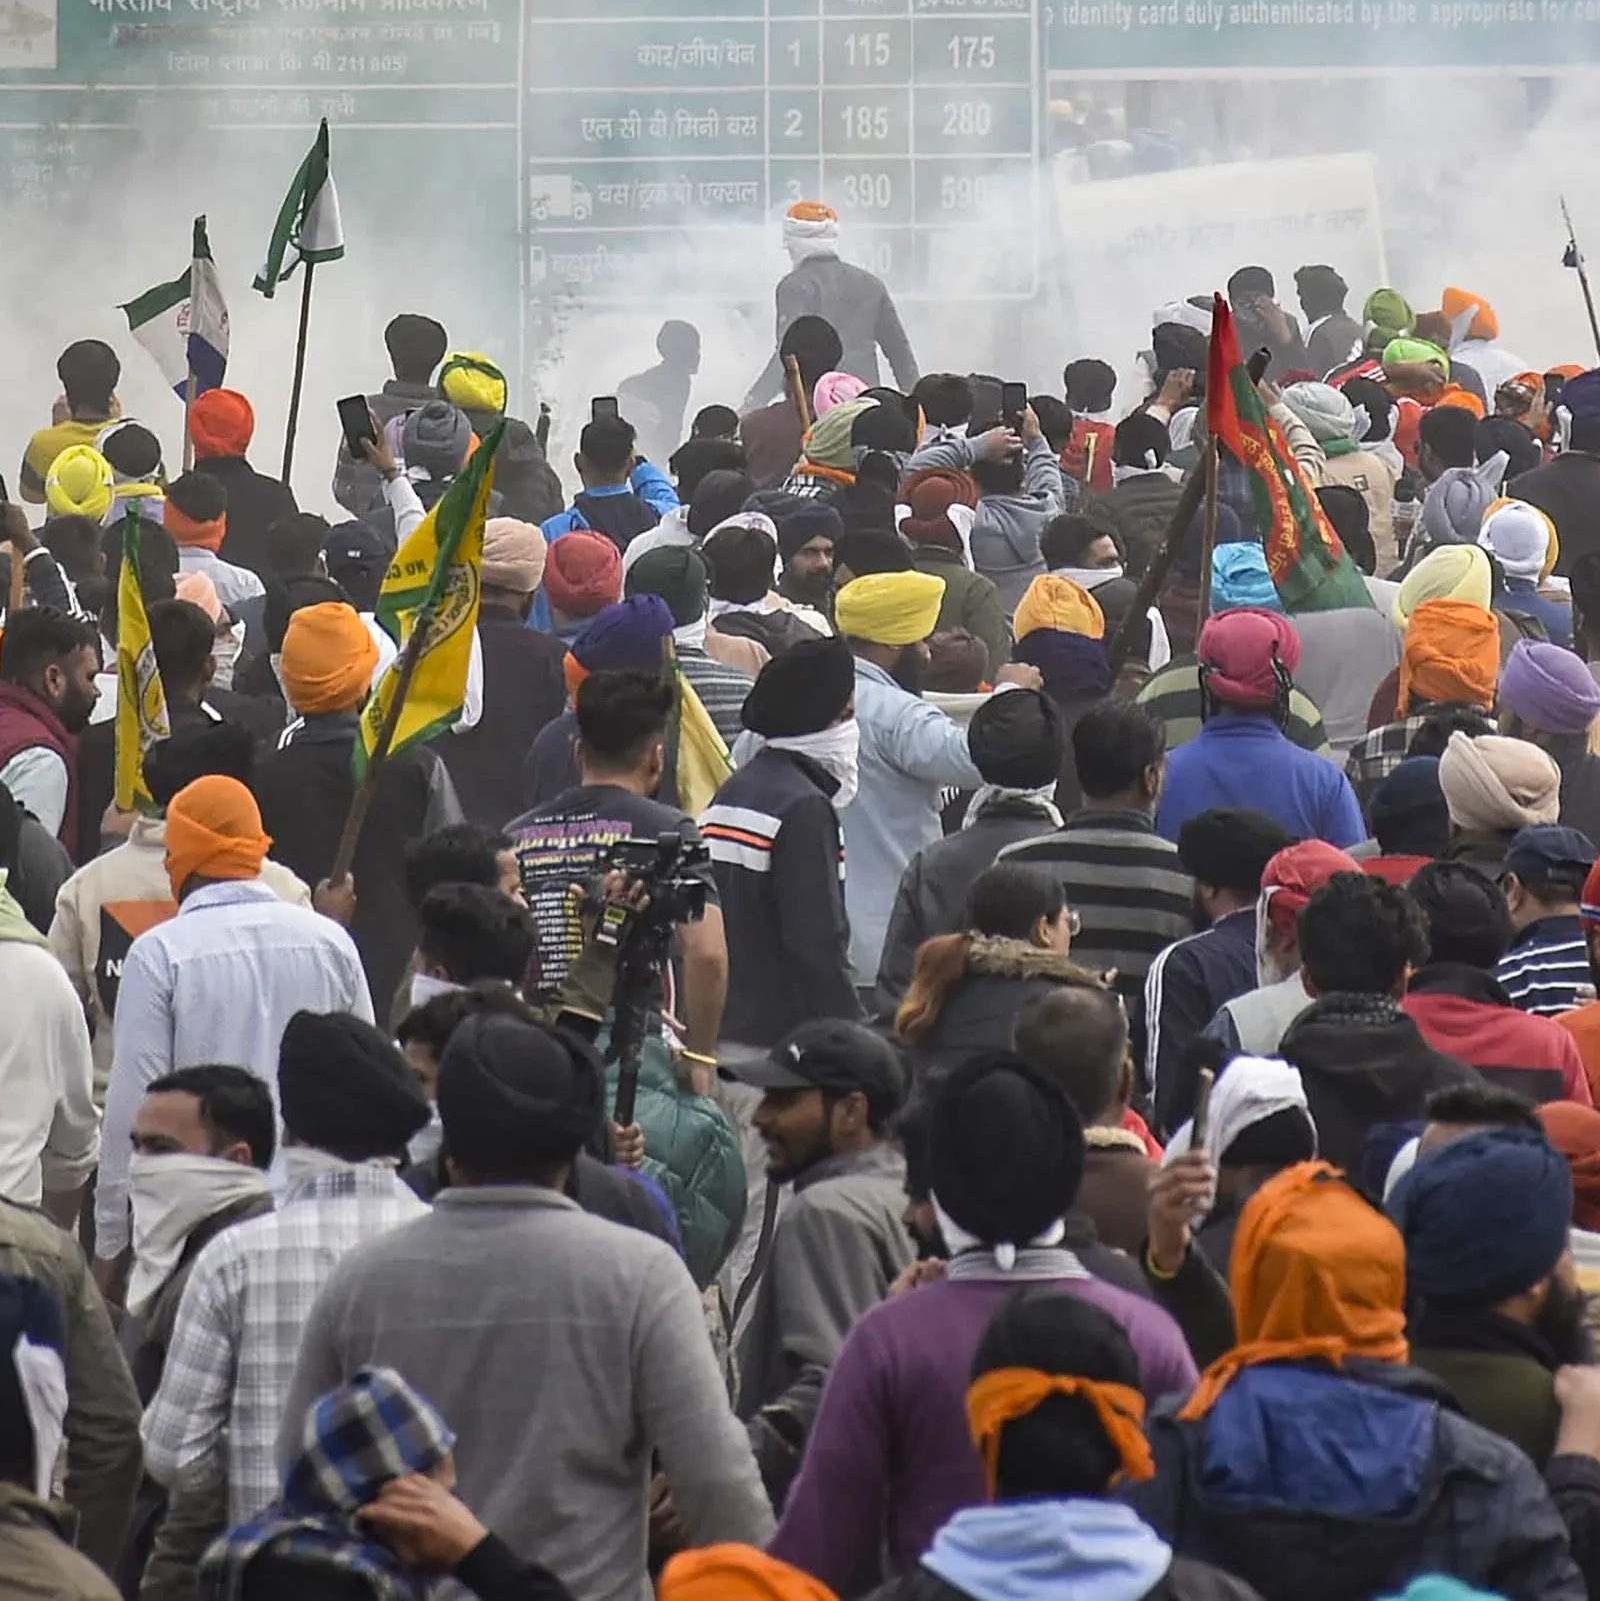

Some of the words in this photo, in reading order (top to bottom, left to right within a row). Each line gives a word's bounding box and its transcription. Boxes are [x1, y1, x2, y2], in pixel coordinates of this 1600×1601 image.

[843, 32, 892, 67] 115
[947, 35, 996, 69] 175
[784, 111, 804, 135] 2
[842, 105, 889, 140] 185
[942, 103, 991, 135] 280
[843, 173, 891, 209] 390
